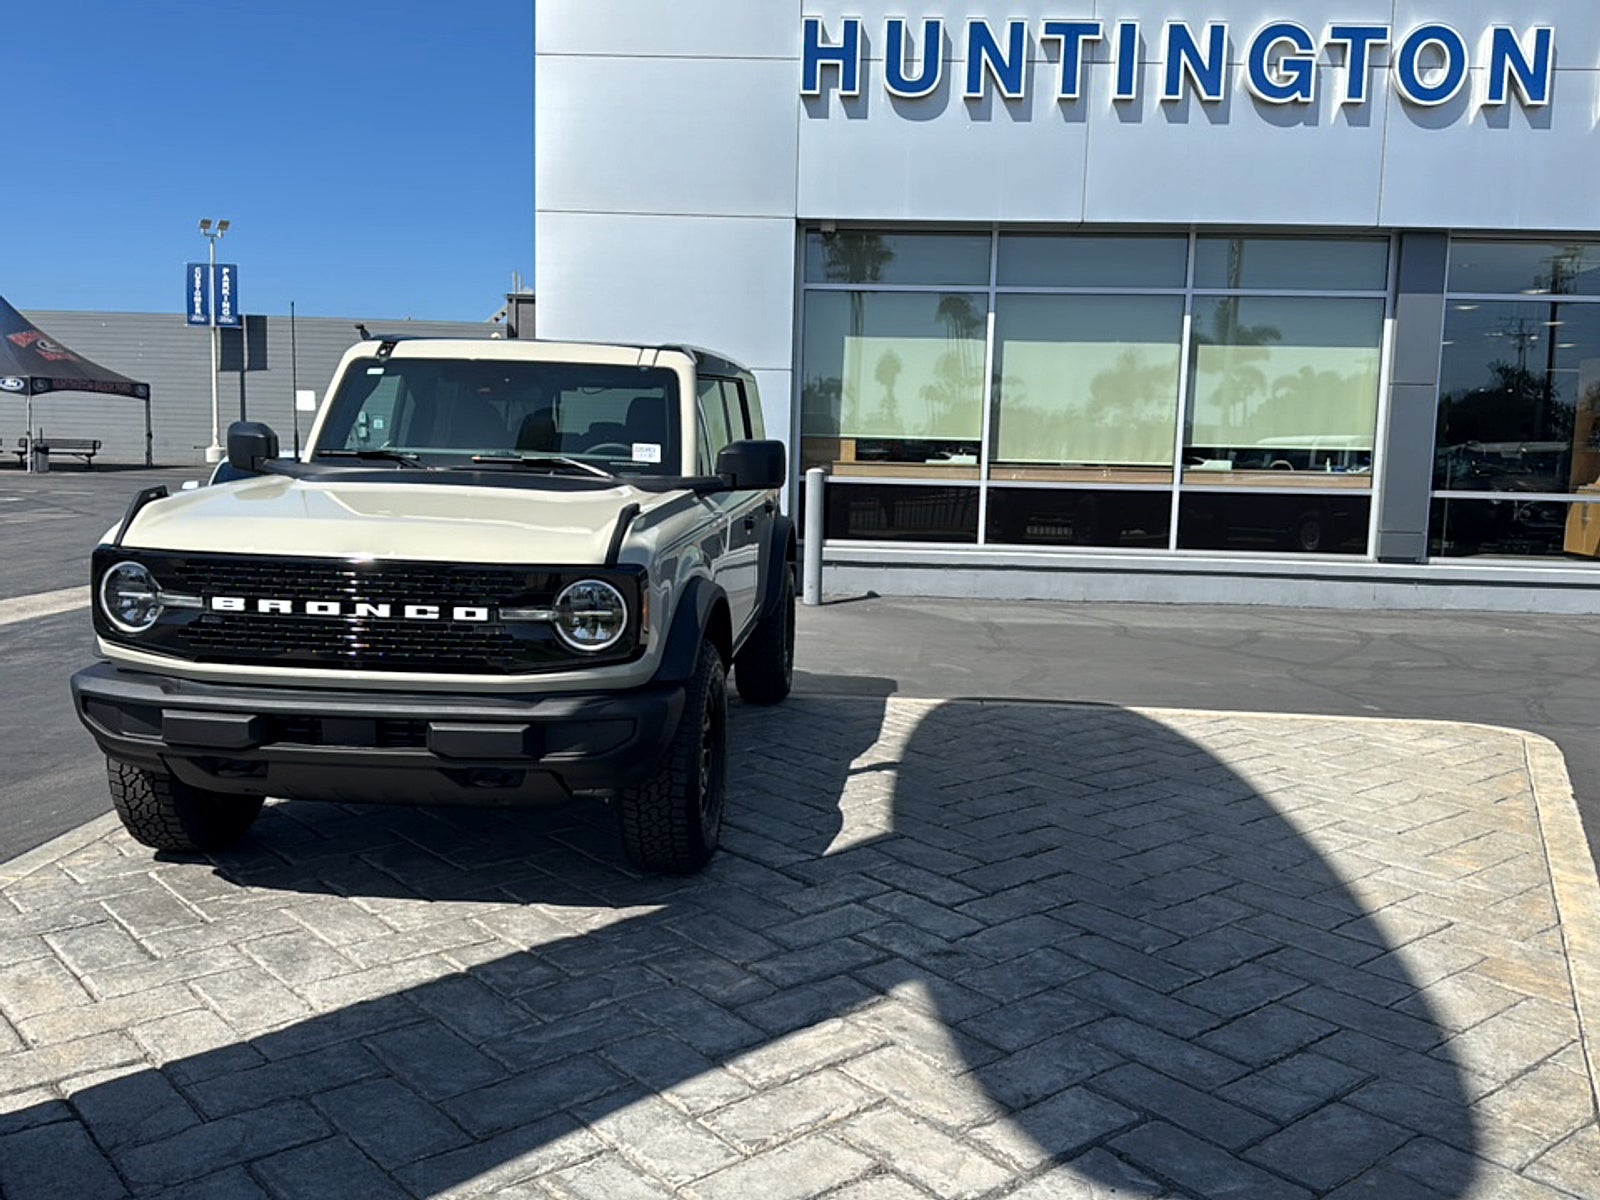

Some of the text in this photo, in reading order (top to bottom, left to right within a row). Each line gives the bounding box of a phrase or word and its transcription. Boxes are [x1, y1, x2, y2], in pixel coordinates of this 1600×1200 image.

[801, 16, 1555, 107] HUNTINGTON
[221, 267, 231, 317] PARKING
[211, 596, 489, 622] BRONCO
